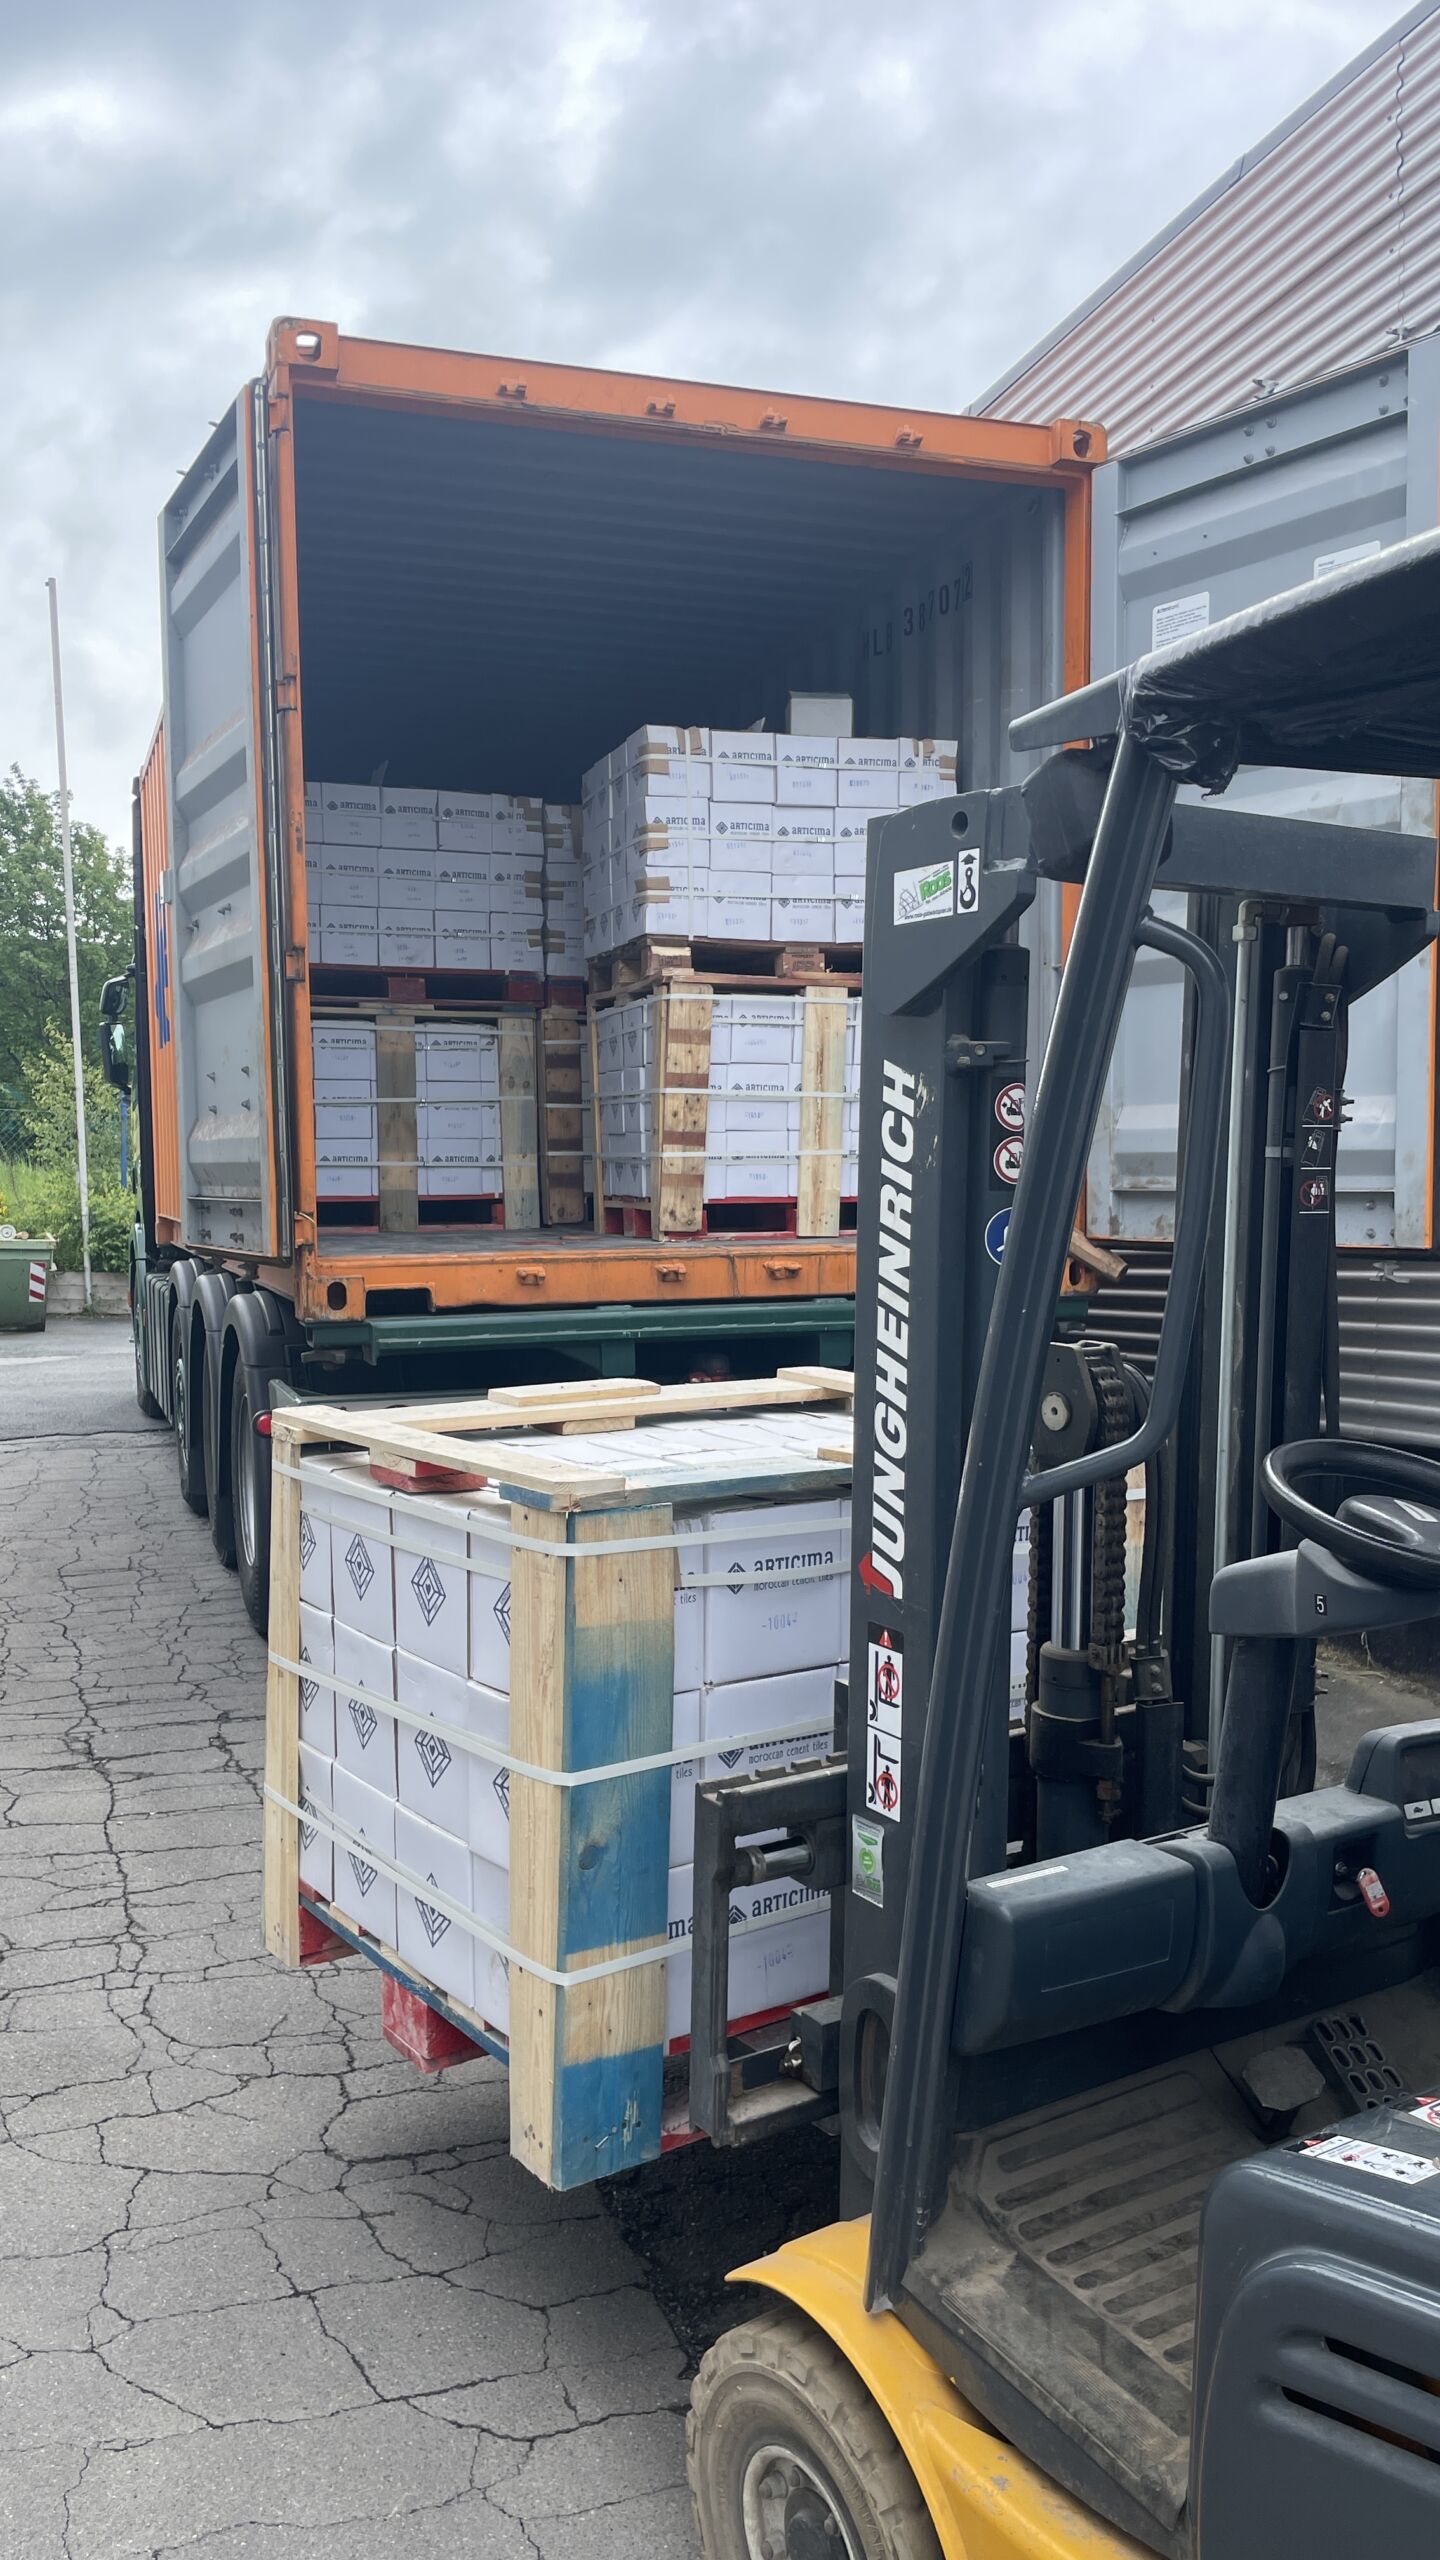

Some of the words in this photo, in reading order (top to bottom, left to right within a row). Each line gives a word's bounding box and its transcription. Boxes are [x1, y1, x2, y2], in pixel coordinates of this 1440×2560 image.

[859, 1059, 916, 1600] JUNGHEINRICH
[1315, 1595, 1326, 1613] 5
[748, 1749, 784, 1765] moroccan
[786, 1744, 810, 1758] cement
[812, 1739, 829, 1751] tiles
[675, 1766, 694, 1780] tiles
